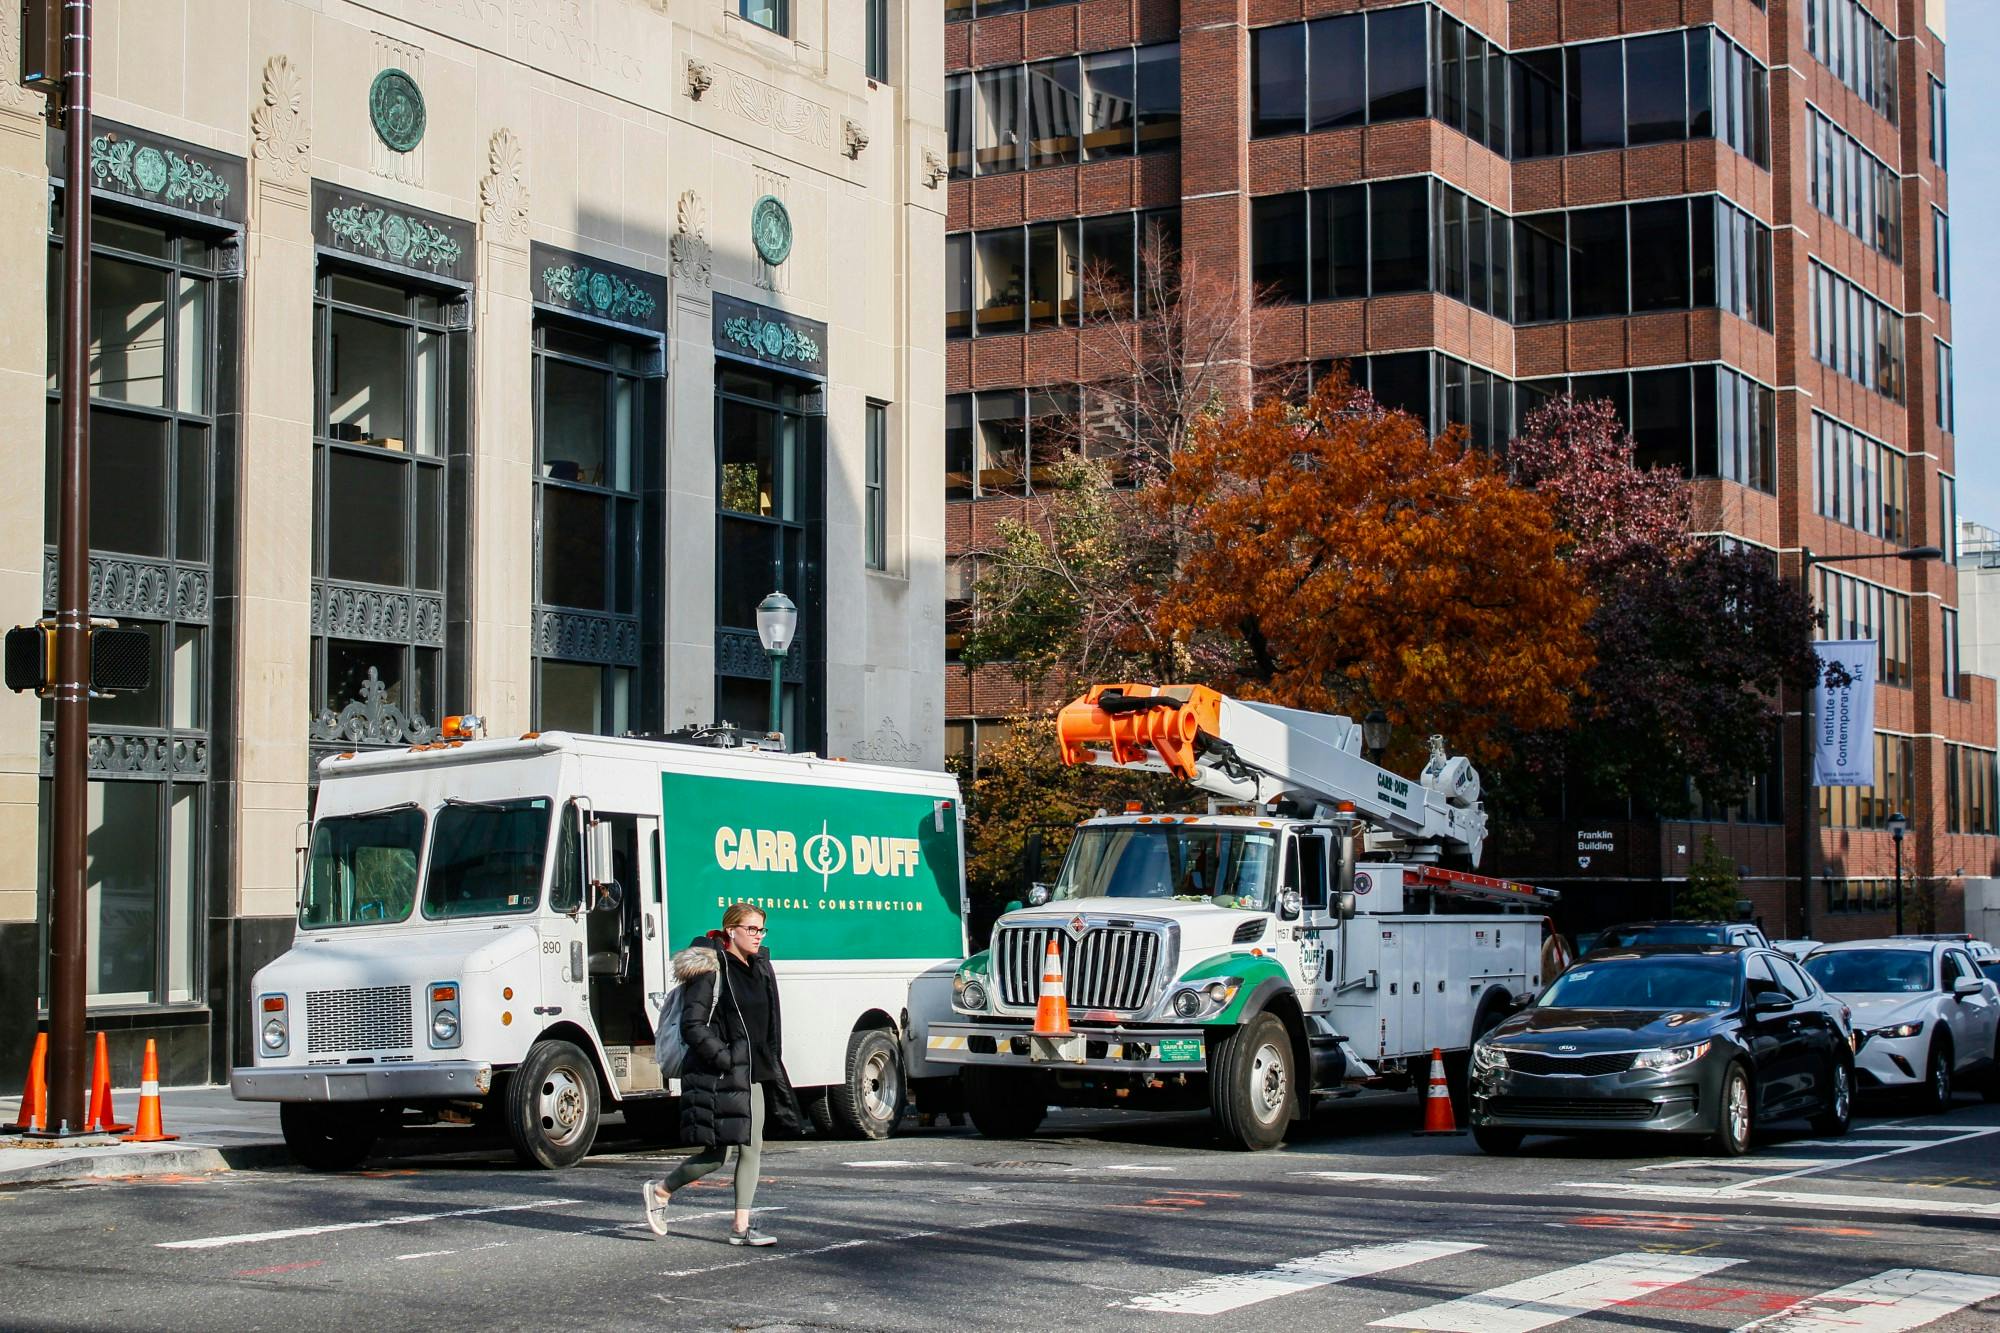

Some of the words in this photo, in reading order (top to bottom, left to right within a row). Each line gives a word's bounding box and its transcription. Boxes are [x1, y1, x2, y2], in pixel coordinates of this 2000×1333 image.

[512, 12, 645, 83] ECONOMICS
[1853, 663, 1863, 681] Art
[1824, 698, 1835, 746] Institute
[1836, 686, 1850, 767] Contemporary
[1377, 772, 1392, 791] CARR
[1395, 780, 1408, 797] DUFF
[1578, 831, 1613, 839] Franklin
[715, 826, 798, 873] CARR
[851, 835, 919, 877] DUFF
[1578, 842, 1614, 851] Building
[718, 896, 809, 910] ELECTRICAL
[818, 899, 923, 912] CONSTRUCTION
[543, 941, 561, 954] 890
[1304, 949, 1320, 963] DUFF
